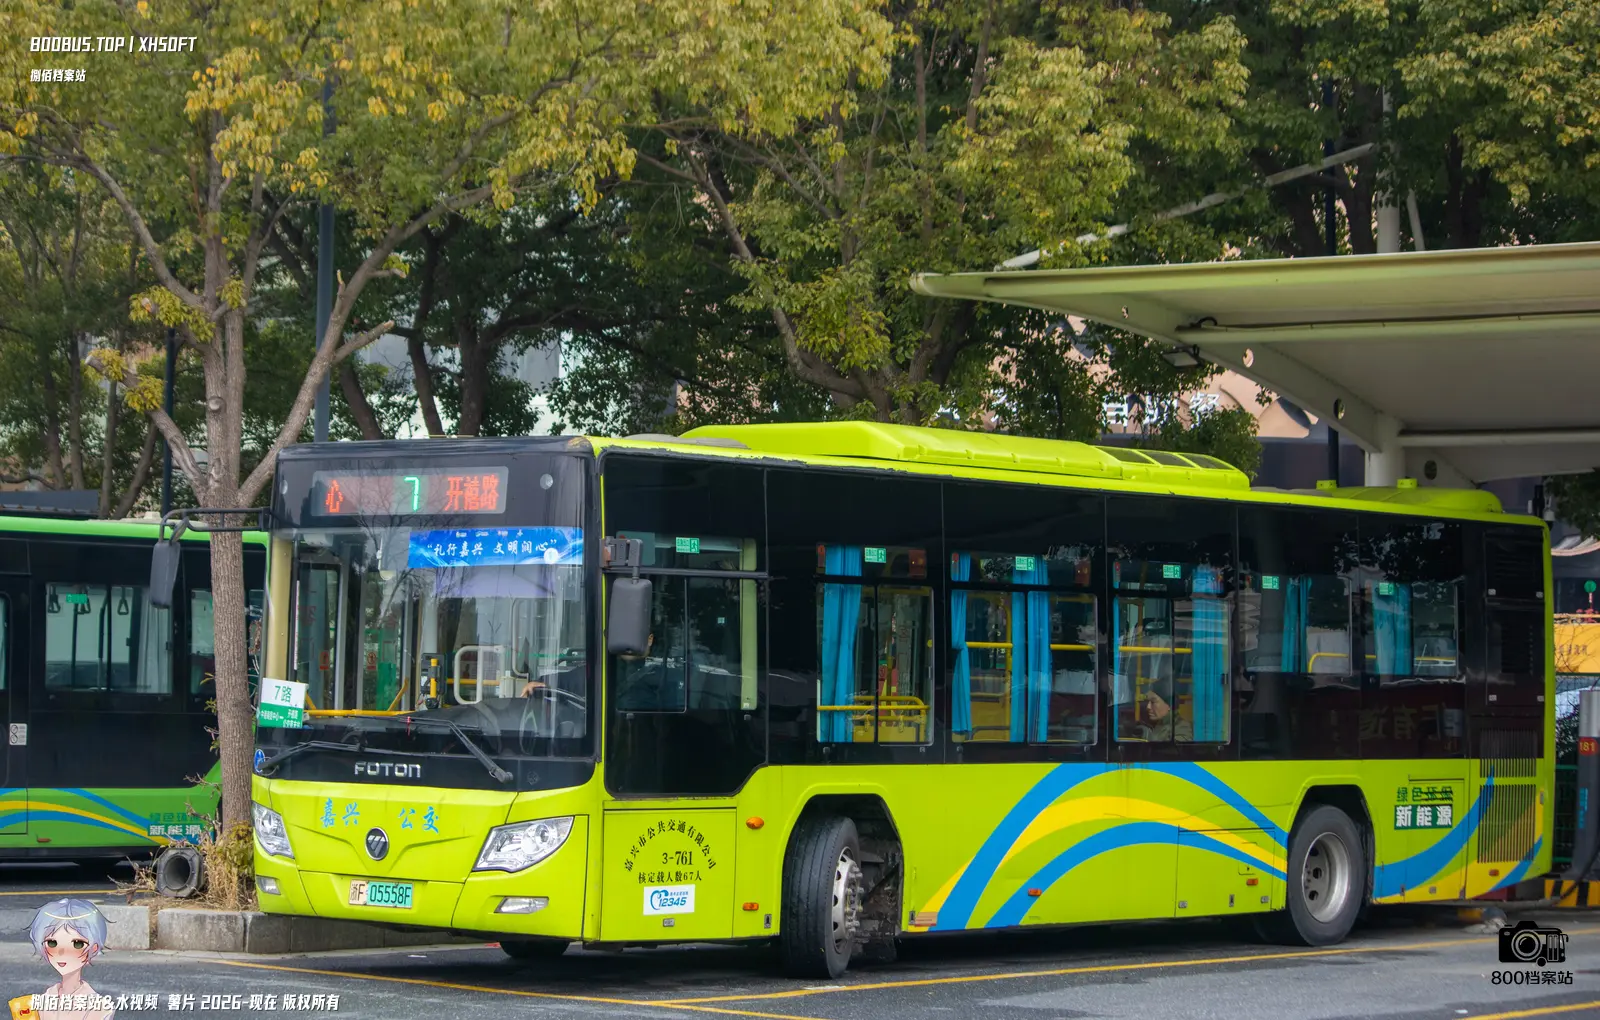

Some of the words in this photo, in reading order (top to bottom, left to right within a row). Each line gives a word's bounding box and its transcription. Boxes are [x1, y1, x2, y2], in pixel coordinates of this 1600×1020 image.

[327, 480, 342, 513] 心
[403, 476, 421, 512] 7
[274, 685, 292, 703] 7路
[354, 761, 421, 778] FOTON
[319, 797, 360, 828] 嘉兴
[398, 805, 440, 834] 公交
[1396, 804, 1452, 826] 新能源
[149, 824, 201, 836] 新能源
[624, 819, 717, 873] 嘉兴市公共交通有限公司
[662, 851, 693, 865] 3-761
[638, 870, 702, 883] 核定载人数67人
[659, 897, 687, 907] 12345
